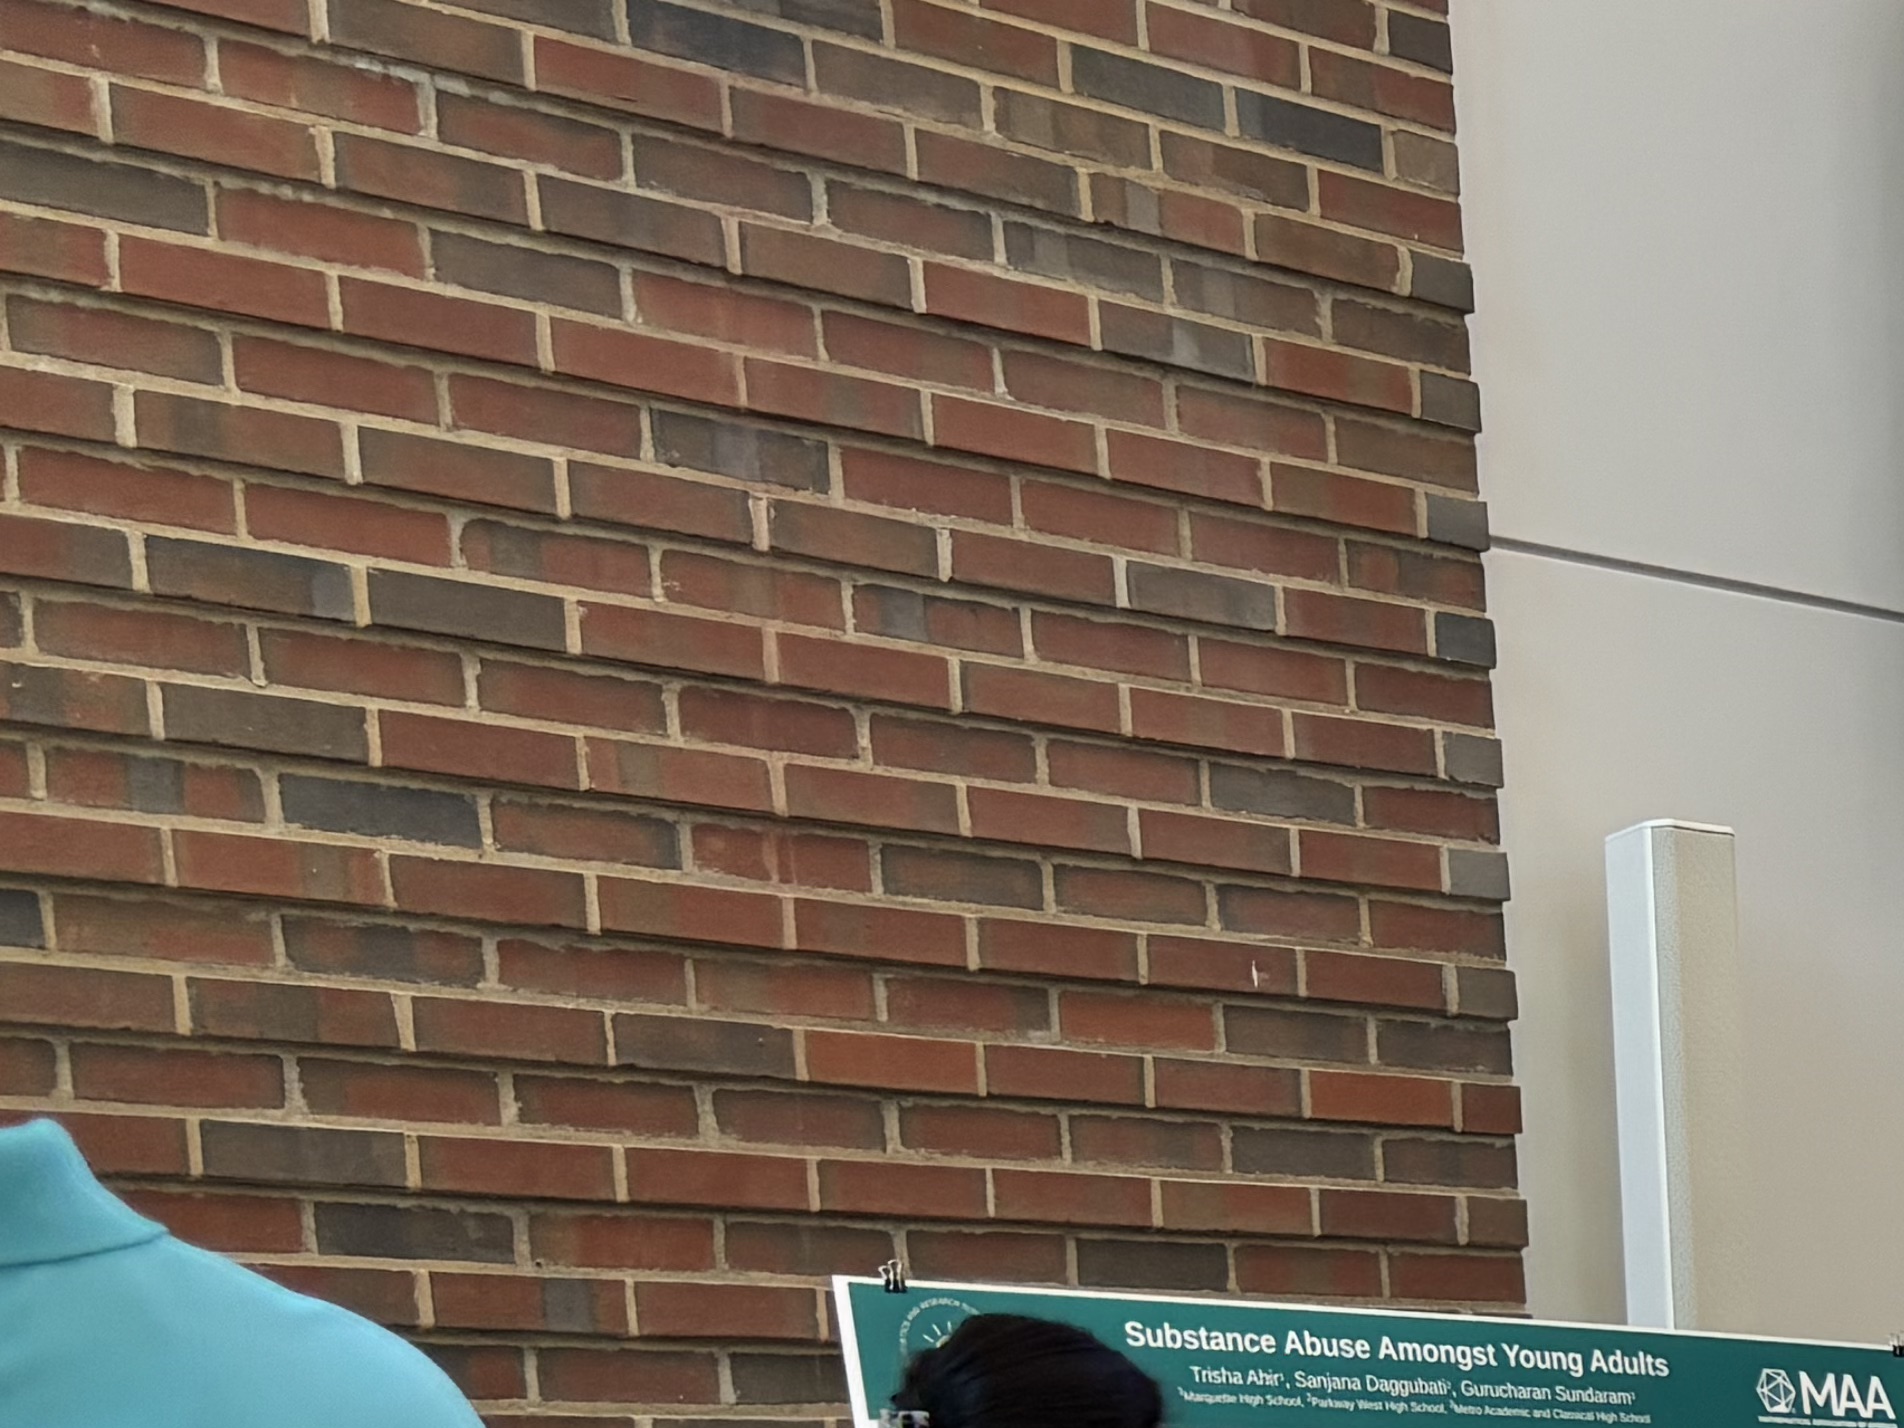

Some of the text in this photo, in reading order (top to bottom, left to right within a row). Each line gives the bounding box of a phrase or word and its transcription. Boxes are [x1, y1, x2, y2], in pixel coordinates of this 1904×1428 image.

[1125, 1321, 1668, 1376] Substance Abuse Amongst Young Adults
[1189, 1365, 1243, 1385] Trisha
[1294, 1371, 1361, 1393] Sanjana
[1461, 1379, 1551, 1401] Gurucharan
[1799, 1371, 1897, 1420] MAA
